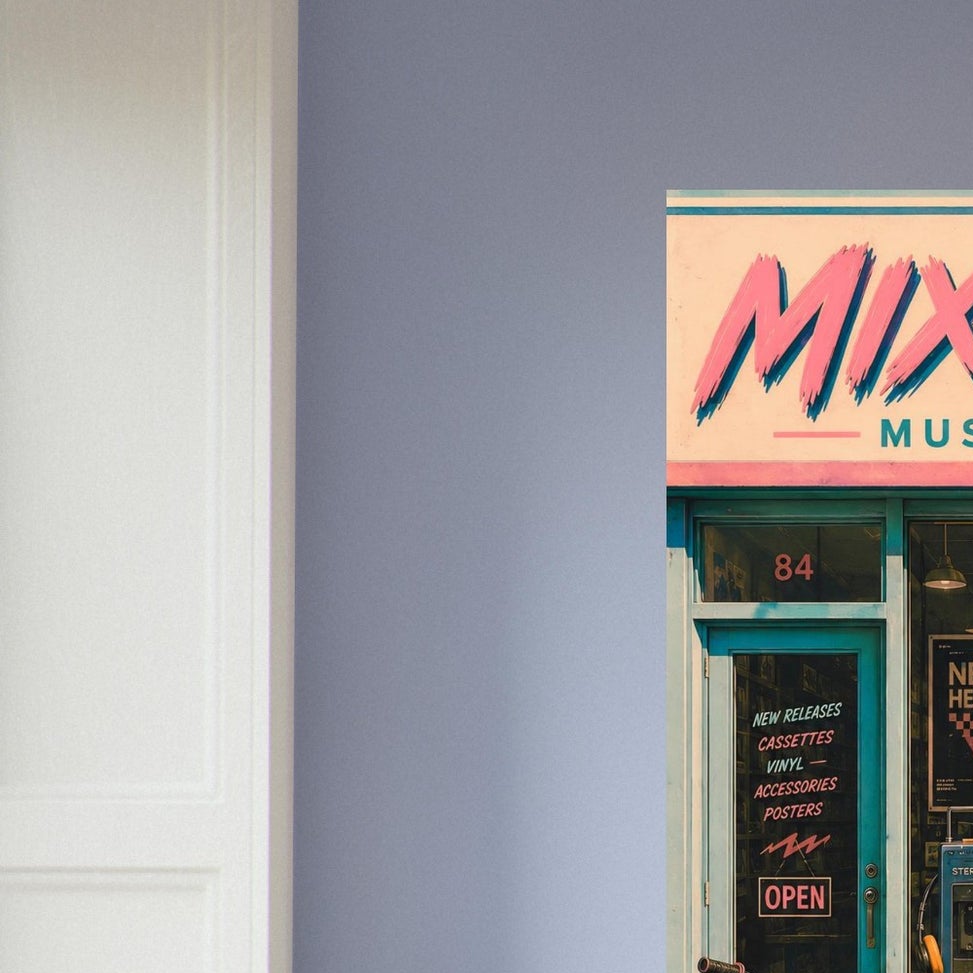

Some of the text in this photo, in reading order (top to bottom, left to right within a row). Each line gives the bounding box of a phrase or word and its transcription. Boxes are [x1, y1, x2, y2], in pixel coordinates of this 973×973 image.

[774, 553, 814, 582] 84
[752, 702, 842, 728] NEW RELEASES
[758, 729, 834, 751] CASSETTES
[766, 757, 804, 774] VINYL
[754, 776, 838, 799] ACCESSORIES
[763, 802, 823, 821] POSTERS
[764, 884, 825, 910] OPEN
